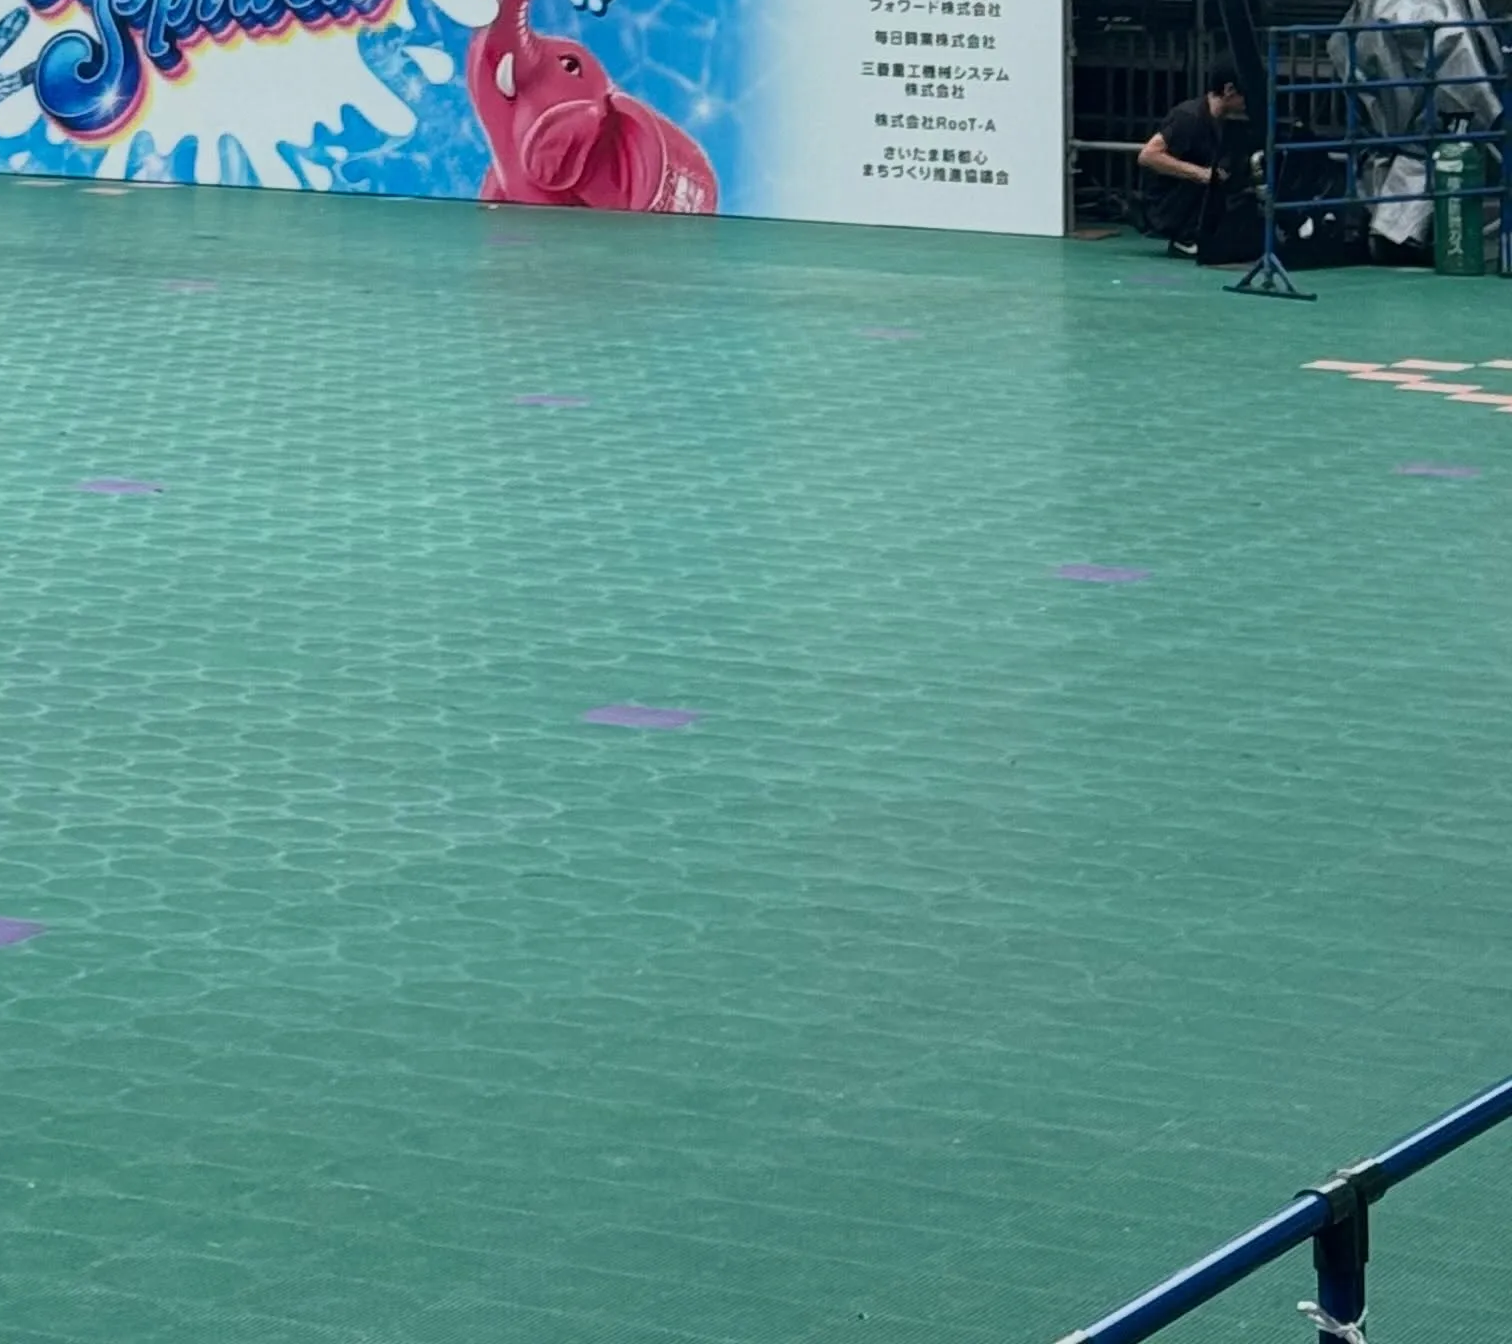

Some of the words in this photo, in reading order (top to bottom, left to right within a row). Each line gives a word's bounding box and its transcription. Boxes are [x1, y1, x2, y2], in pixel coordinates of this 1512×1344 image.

[875, 30, 996, 49] 毎日興業株式会社
[861, 62, 1010, 81] 三菱重工機械システム
[905, 83, 965, 99] 株式会社
[883, 146, 988, 165] さいたま新都心
[863, 164, 1009, 185] まちづくり推進協議会
